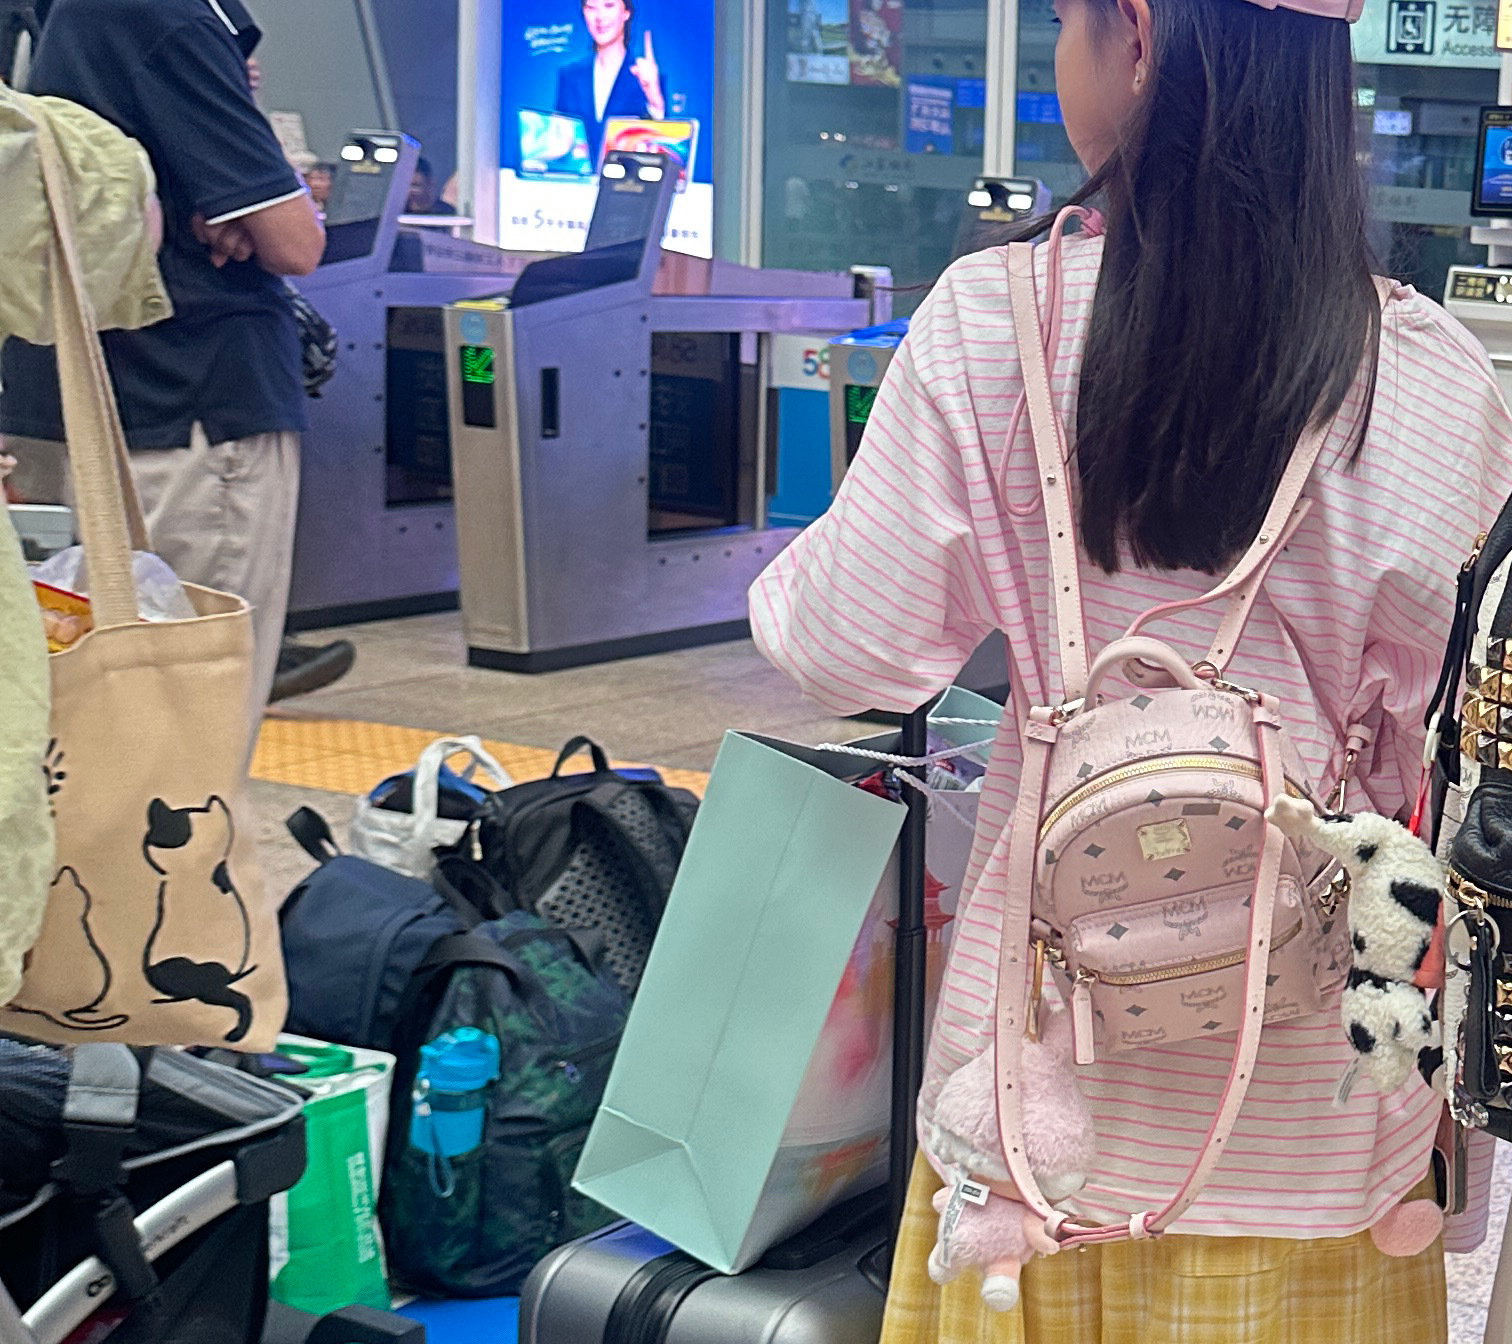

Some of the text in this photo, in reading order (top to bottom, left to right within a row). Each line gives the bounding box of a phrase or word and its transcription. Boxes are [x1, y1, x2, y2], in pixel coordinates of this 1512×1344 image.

[1191, 704, 1235, 723] MCM
[1125, 727, 1172, 749] MCM
[1081, 871, 1127, 891] MCM
[1161, 896, 1206, 917] MCM
[1180, 985, 1227, 1003] MCM
[1121, 1026, 1167, 1039] MCM
